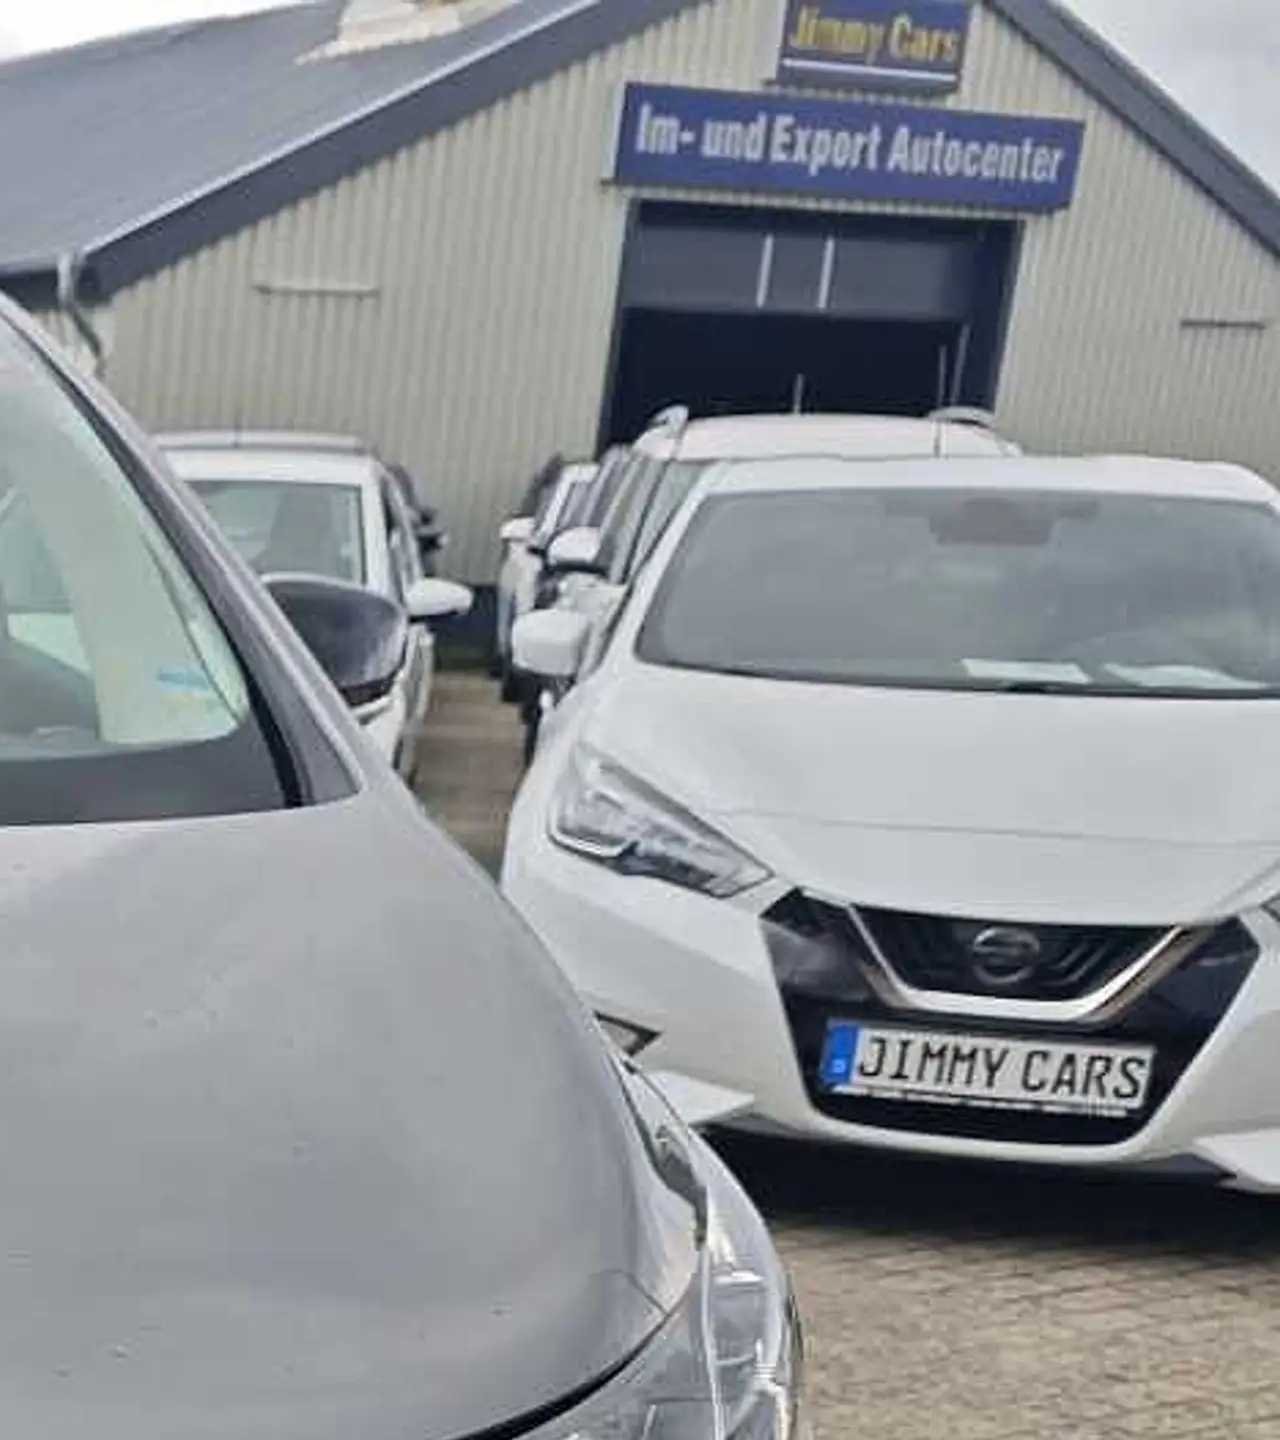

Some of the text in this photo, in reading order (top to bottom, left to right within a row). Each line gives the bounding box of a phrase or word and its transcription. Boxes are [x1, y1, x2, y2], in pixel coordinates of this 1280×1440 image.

[790, 6, 960, 66] Jimmy Cars
[634, 103, 1065, 184] Im- und Export Autocenter
[858, 1037, 1148, 1100] JIMMY CARS
